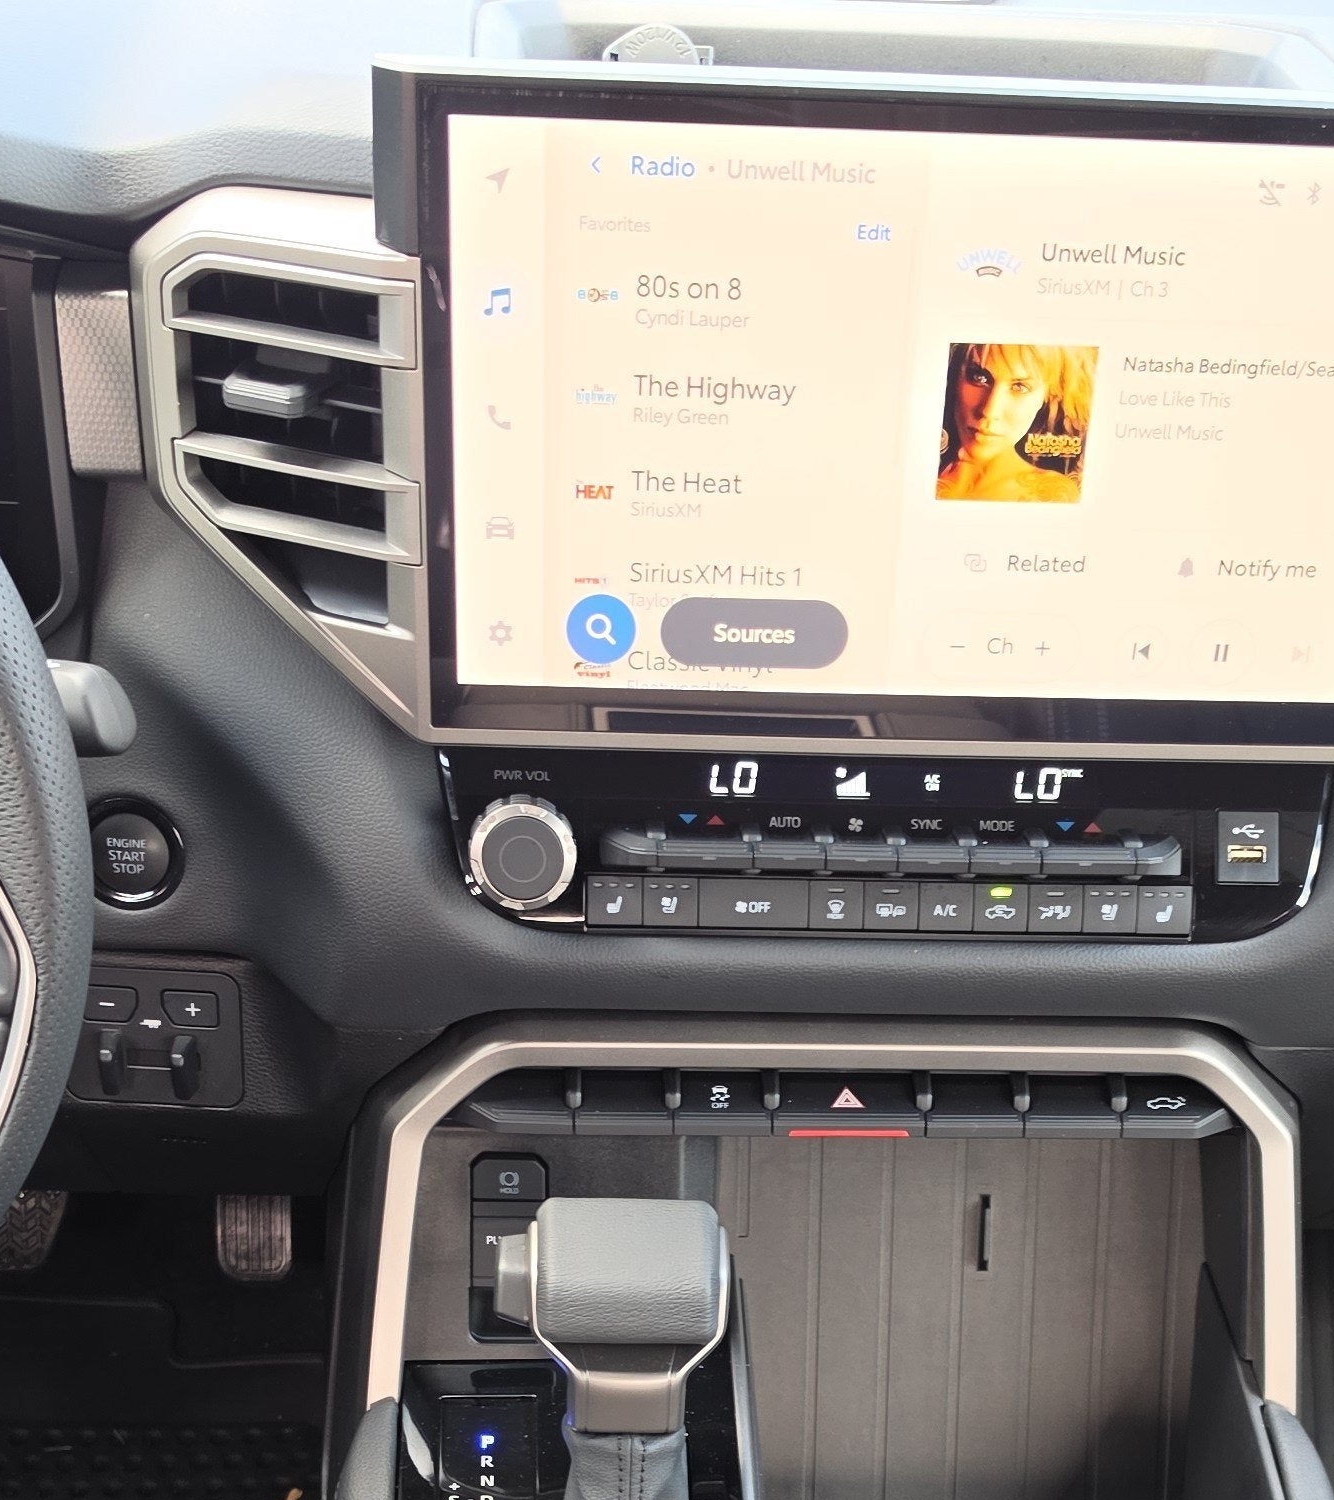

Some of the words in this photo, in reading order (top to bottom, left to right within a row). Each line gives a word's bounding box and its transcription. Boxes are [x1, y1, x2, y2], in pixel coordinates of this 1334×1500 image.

[630, 154, 696, 178] Radio
[726, 158, 806, 183] Unwell
[811, 161, 877, 184] Music
[578, 215, 652, 234] Favorites
[856, 223, 892, 242] Edit
[1041, 242, 1118, 266] Unwell
[1123, 245, 1187, 268] Music
[635, 274, 681, 300] 80s
[687, 280, 720, 301] on
[726, 277, 743, 301] 8
[1036, 277, 1112, 298] SiriusXM
[1130, 280, 1156, 298] Ch
[1158, 281, 1169, 298] 3
[634, 308, 685, 331] Cyndi
[690, 310, 750, 332] Lauper
[1123, 356, 1195, 375] Natasha
[575, 390, 617, 404] highway
[632, 374, 680, 399] The
[685, 376, 797, 408] Highway
[1118, 391, 1159, 408] Love
[1161, 392, 1195, 408] Like
[1198, 392, 1232, 409] This
[632, 407, 674, 428] Riley
[677, 408, 730, 426] Green
[1114, 423, 1172, 441] Unwell
[1176, 425, 1224, 442] Music
[631, 469, 676, 492] The
[683, 471, 743, 495] Heat
[575, 485, 614, 500] HEAT
[630, 501, 702, 519] SiriusXM
[1006, 554, 1087, 574] Related
[1217, 559, 1280, 581] Notify
[1285, 564, 1318, 579] me
[629, 562, 733, 585] SiriusXM
[740, 565, 786, 587] Hits
[794, 567, 803, 587] 1
[712, 622, 796, 645] Sources
[986, 637, 1014, 656] Ch
[493, 769, 523, 781] PWR
[524, 770, 551, 782] VOL
[709, 760, 760, 796] LO
[1013, 766, 1063, 800] LO
[769, 816, 802, 829] AUTO
[910, 818, 943, 831] SYNC
[979, 819, 1016, 832] MODE
[106, 837, 147, 849] ENGINE
[108, 849, 146, 862] START
[112, 862, 145, 875] STOP
[748, 900, 772, 914] OFF
[932, 903, 959, 918] A/C
[710, 1101, 730, 1110] OFF
[480, 1434, 495, 1450] P
[480, 1455, 495, 1468] R
[480, 1475, 495, 1488] N
